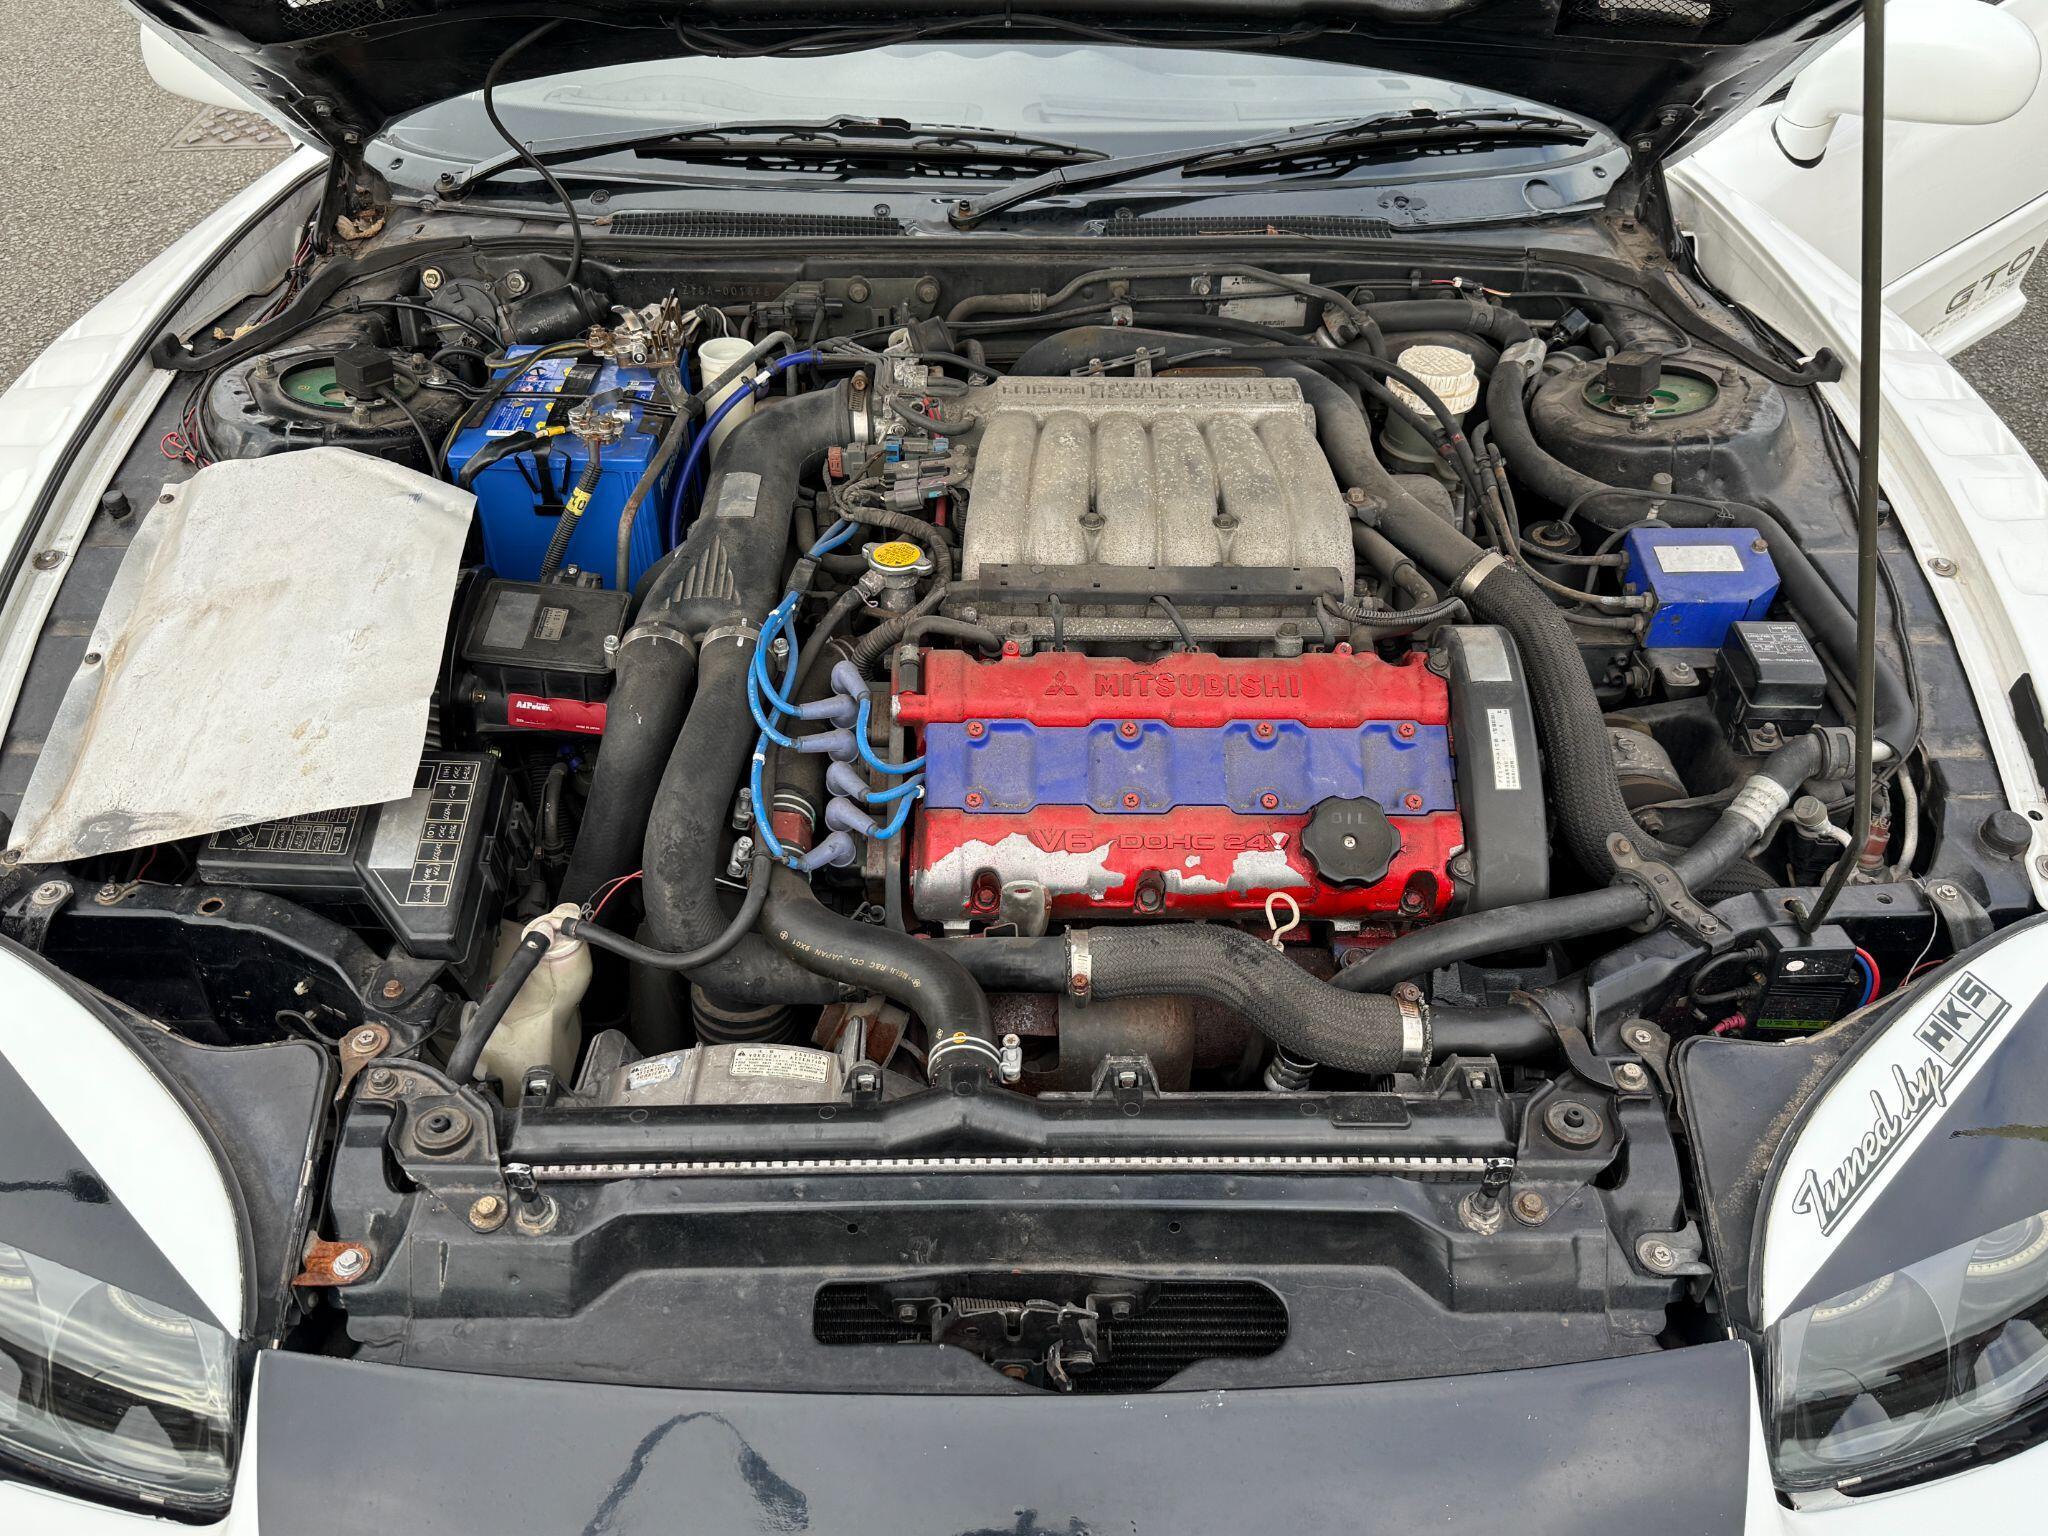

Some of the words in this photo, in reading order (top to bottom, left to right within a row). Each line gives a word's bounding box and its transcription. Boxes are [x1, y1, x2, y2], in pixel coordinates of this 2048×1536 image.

[1945, 246, 2035, 314] GTO
[1093, 672, 1303, 698] MITSUBISHI
[1033, 828, 1094, 852] V6
[1118, 833, 1216, 851] DOHC
[1331, 812, 1368, 825] OIL
[814, 948, 843, 961] JAPAN
[1918, 976, 1991, 1053] HKS
[1892, 1057, 1948, 1121] by
[1791, 1090, 1903, 1230] Tuned
